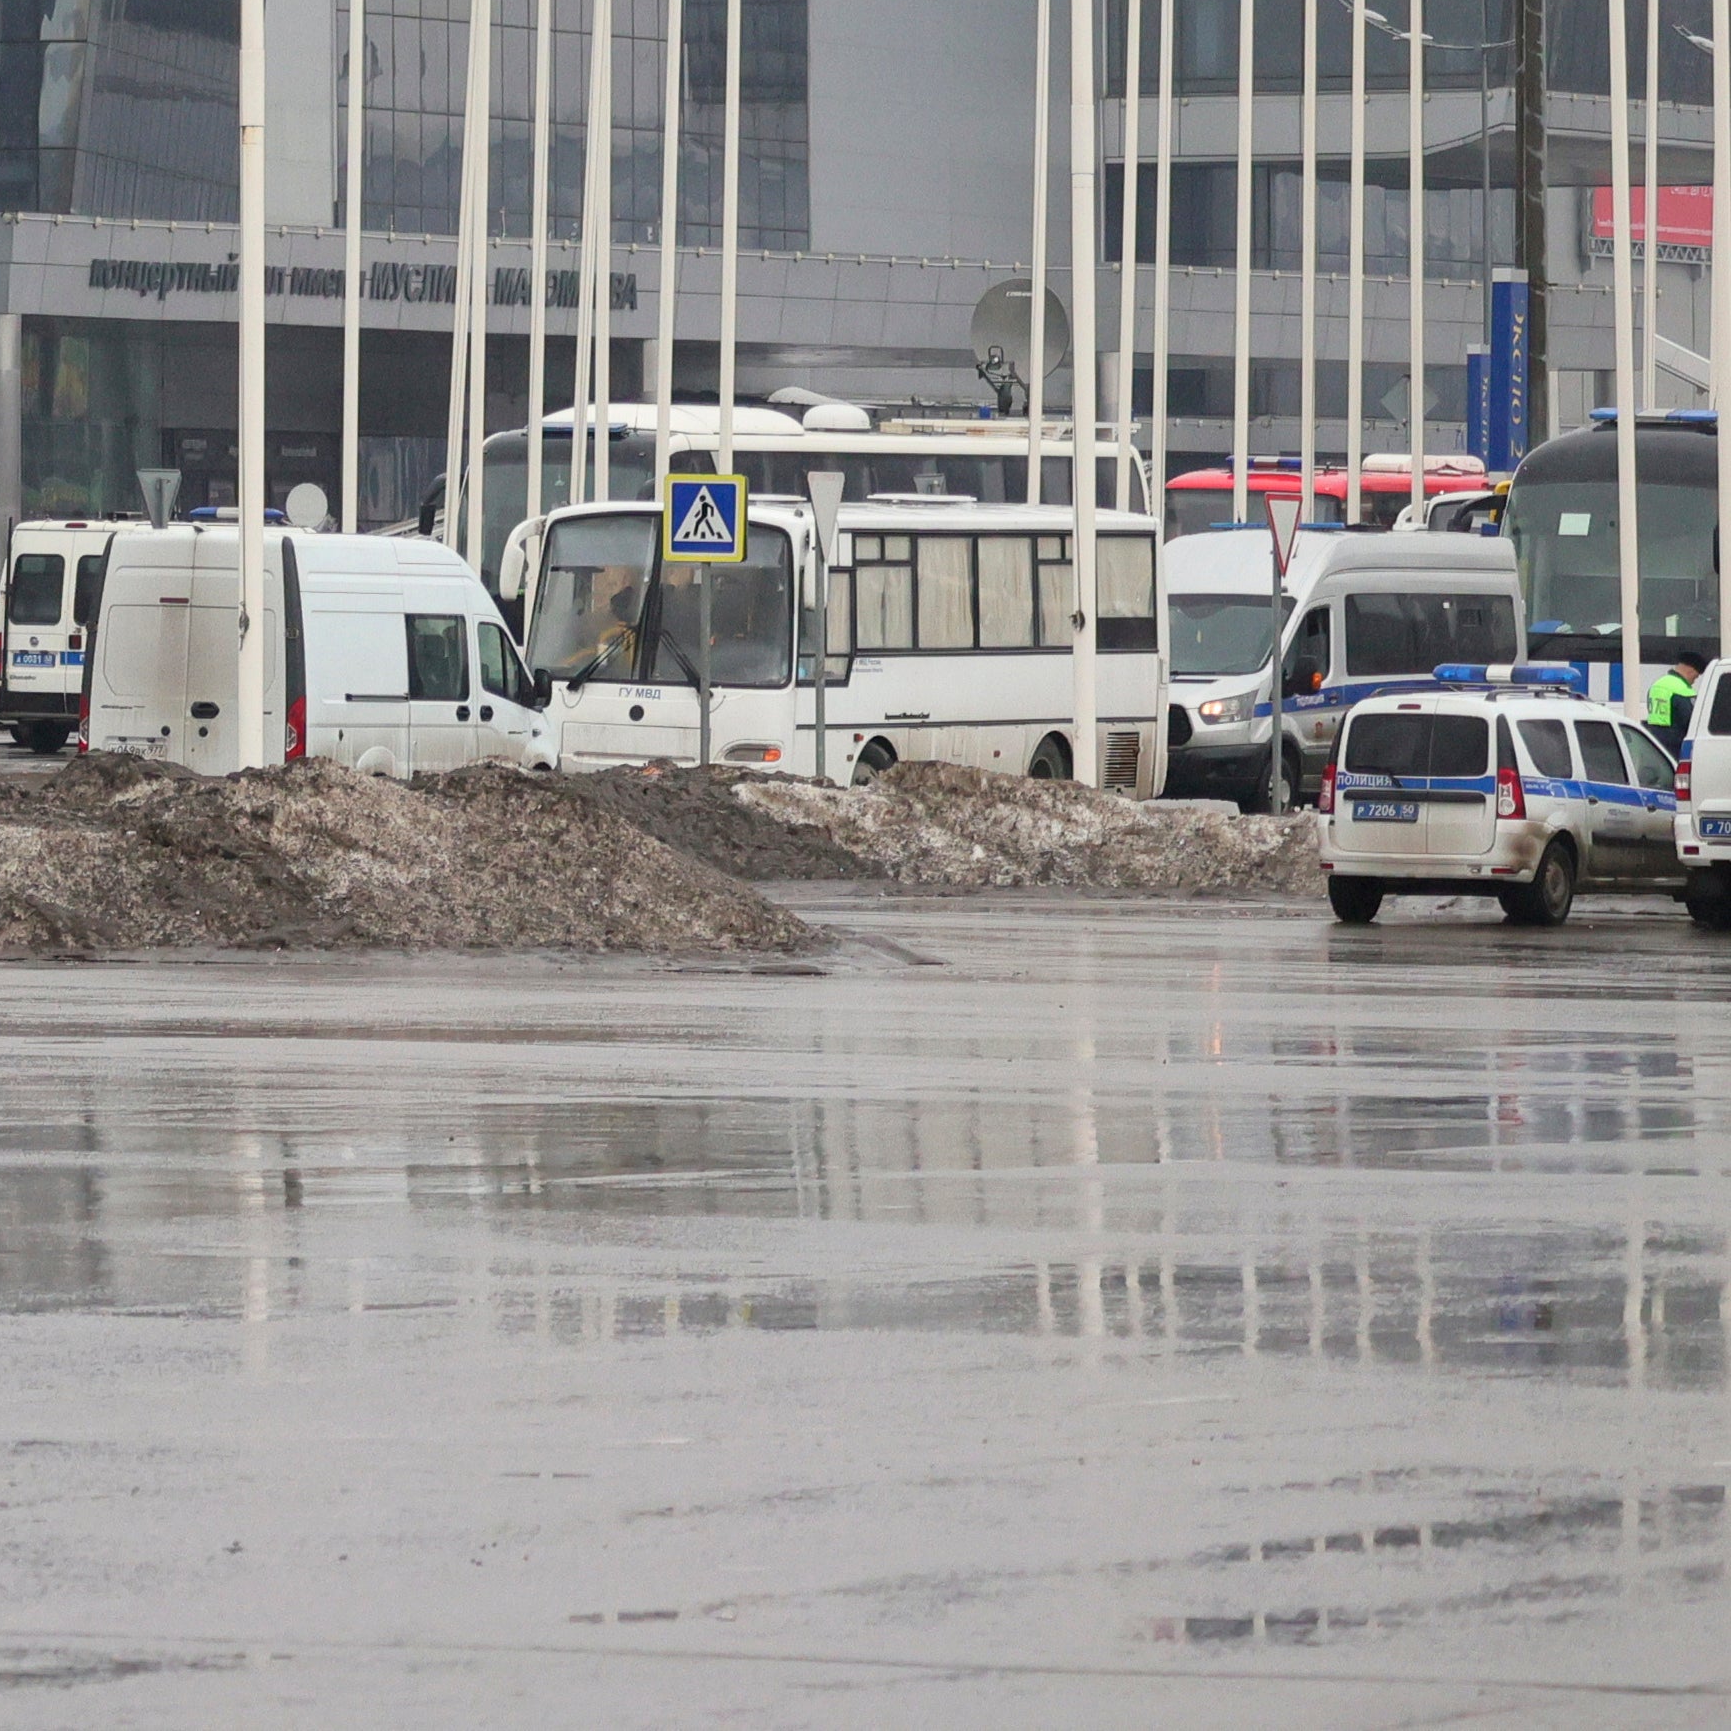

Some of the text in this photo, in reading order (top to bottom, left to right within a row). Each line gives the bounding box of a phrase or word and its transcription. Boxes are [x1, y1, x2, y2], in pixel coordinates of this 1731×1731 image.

[369, 261, 488, 305] МУСЛИ
[493, 267, 638, 310] МАОМВА
[619, 687, 661, 700] ГУ МВД
[1337, 775, 1393, 787] ПОЛИЦИЯ
[1368, 805, 1397, 817] 7206
[1717, 821, 1731, 833] 70
